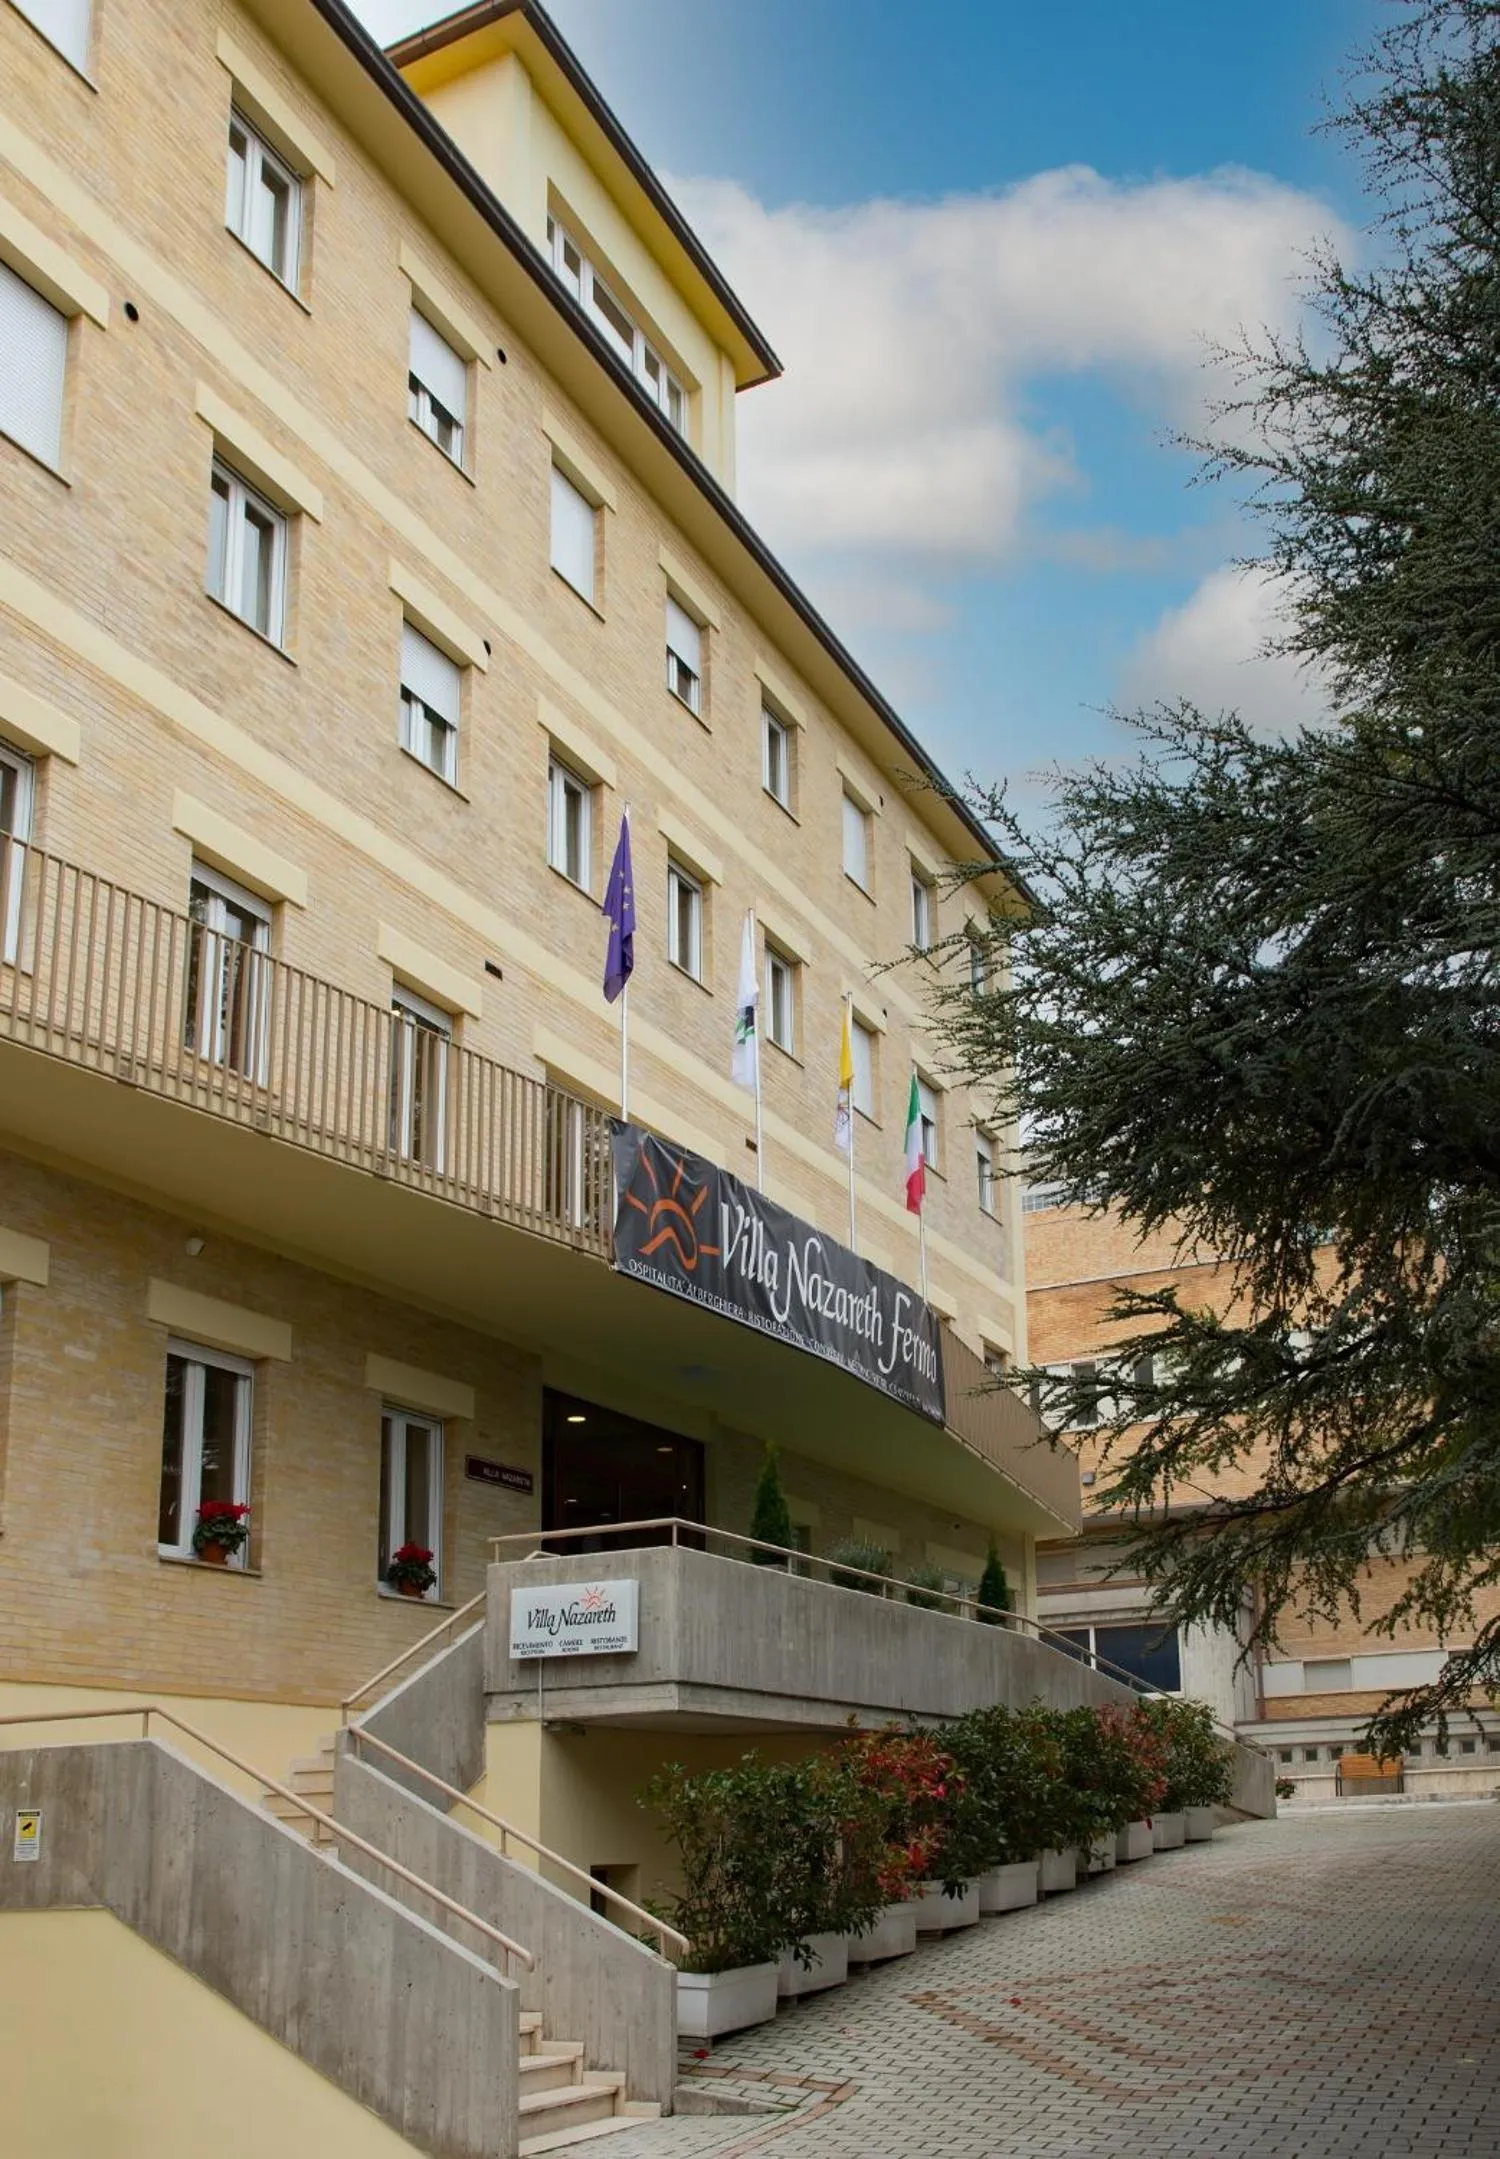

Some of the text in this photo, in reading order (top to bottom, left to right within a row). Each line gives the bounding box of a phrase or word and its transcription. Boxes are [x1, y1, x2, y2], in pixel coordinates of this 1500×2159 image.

[720, 1201, 778, 1291] Villa
[770, 1237, 883, 1347] Nazareth
[527, 1602, 616, 1636] Villa Nazareth
